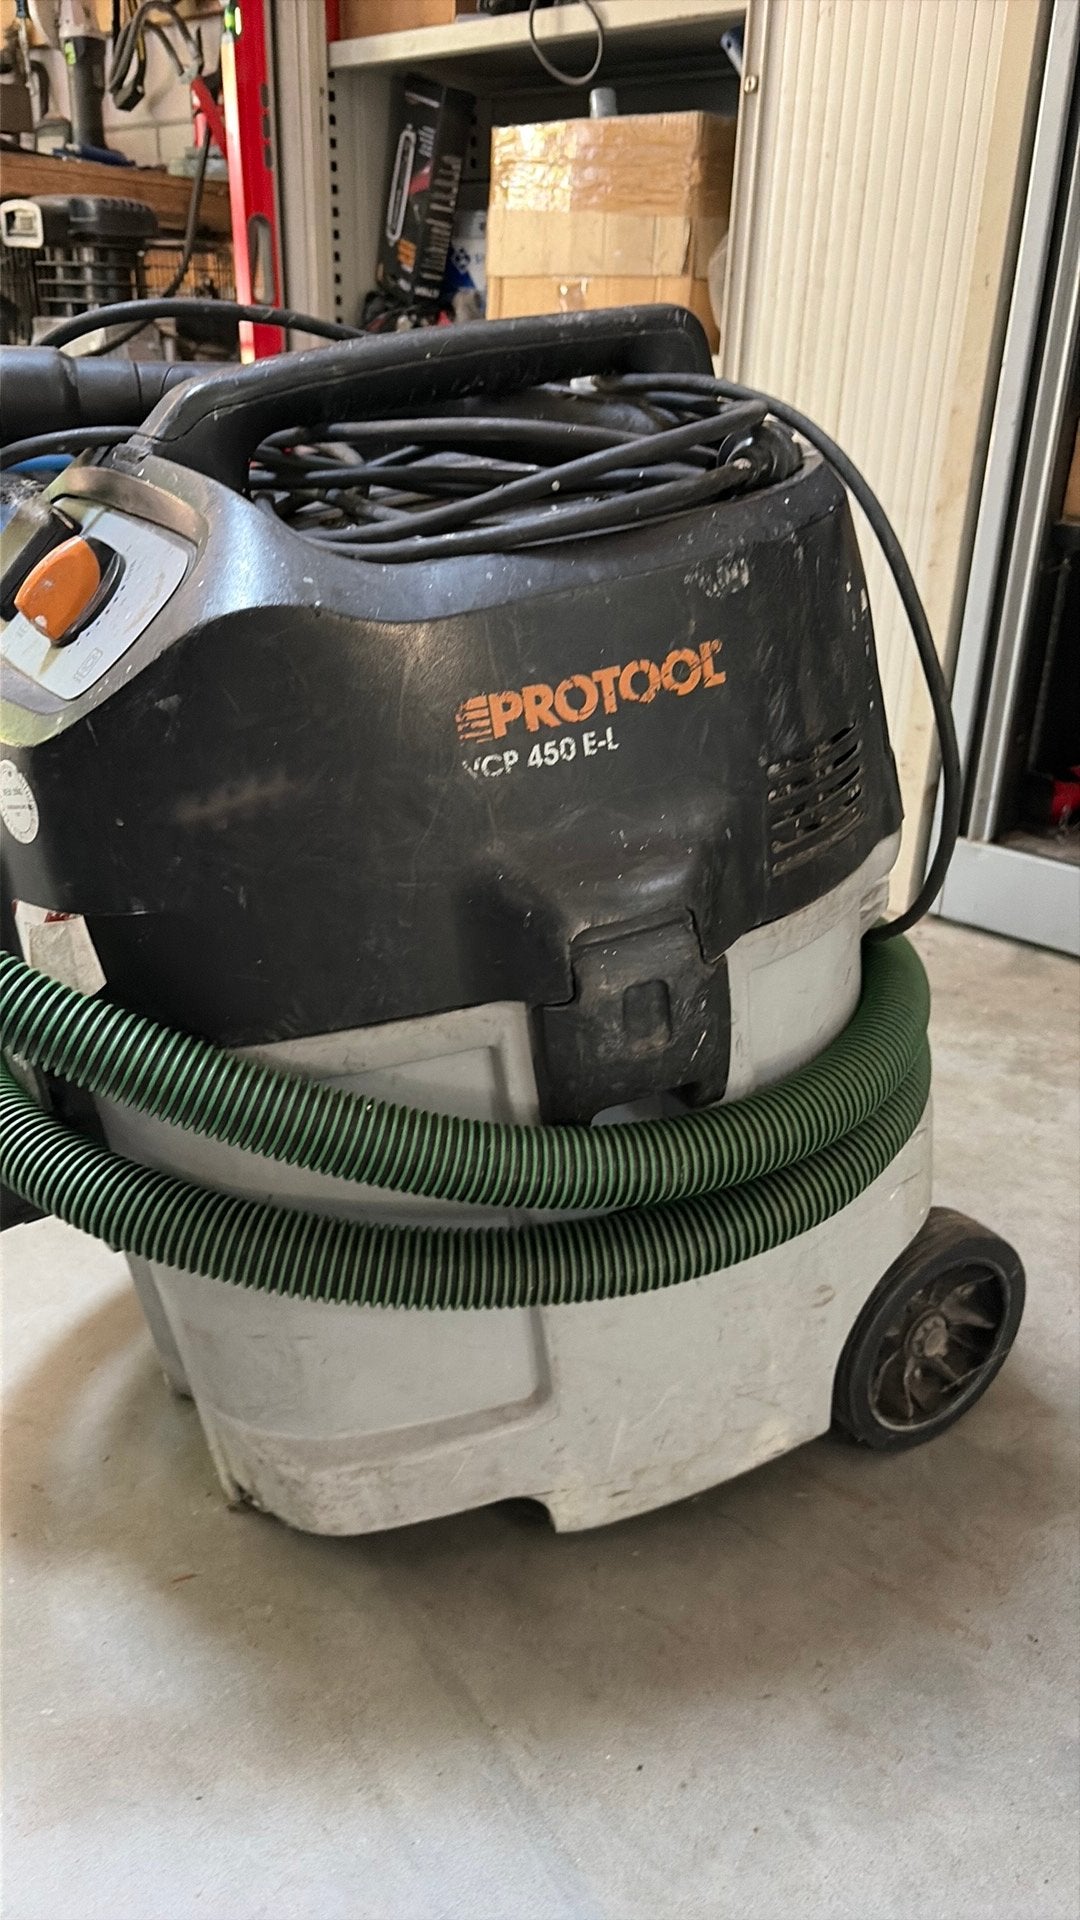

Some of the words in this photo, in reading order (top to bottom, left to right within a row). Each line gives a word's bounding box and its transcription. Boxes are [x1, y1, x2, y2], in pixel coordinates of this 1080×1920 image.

[488, 639, 726, 739] PROTOOL
[527, 736, 577, 768] 450
[582, 727, 620, 758] E-L
